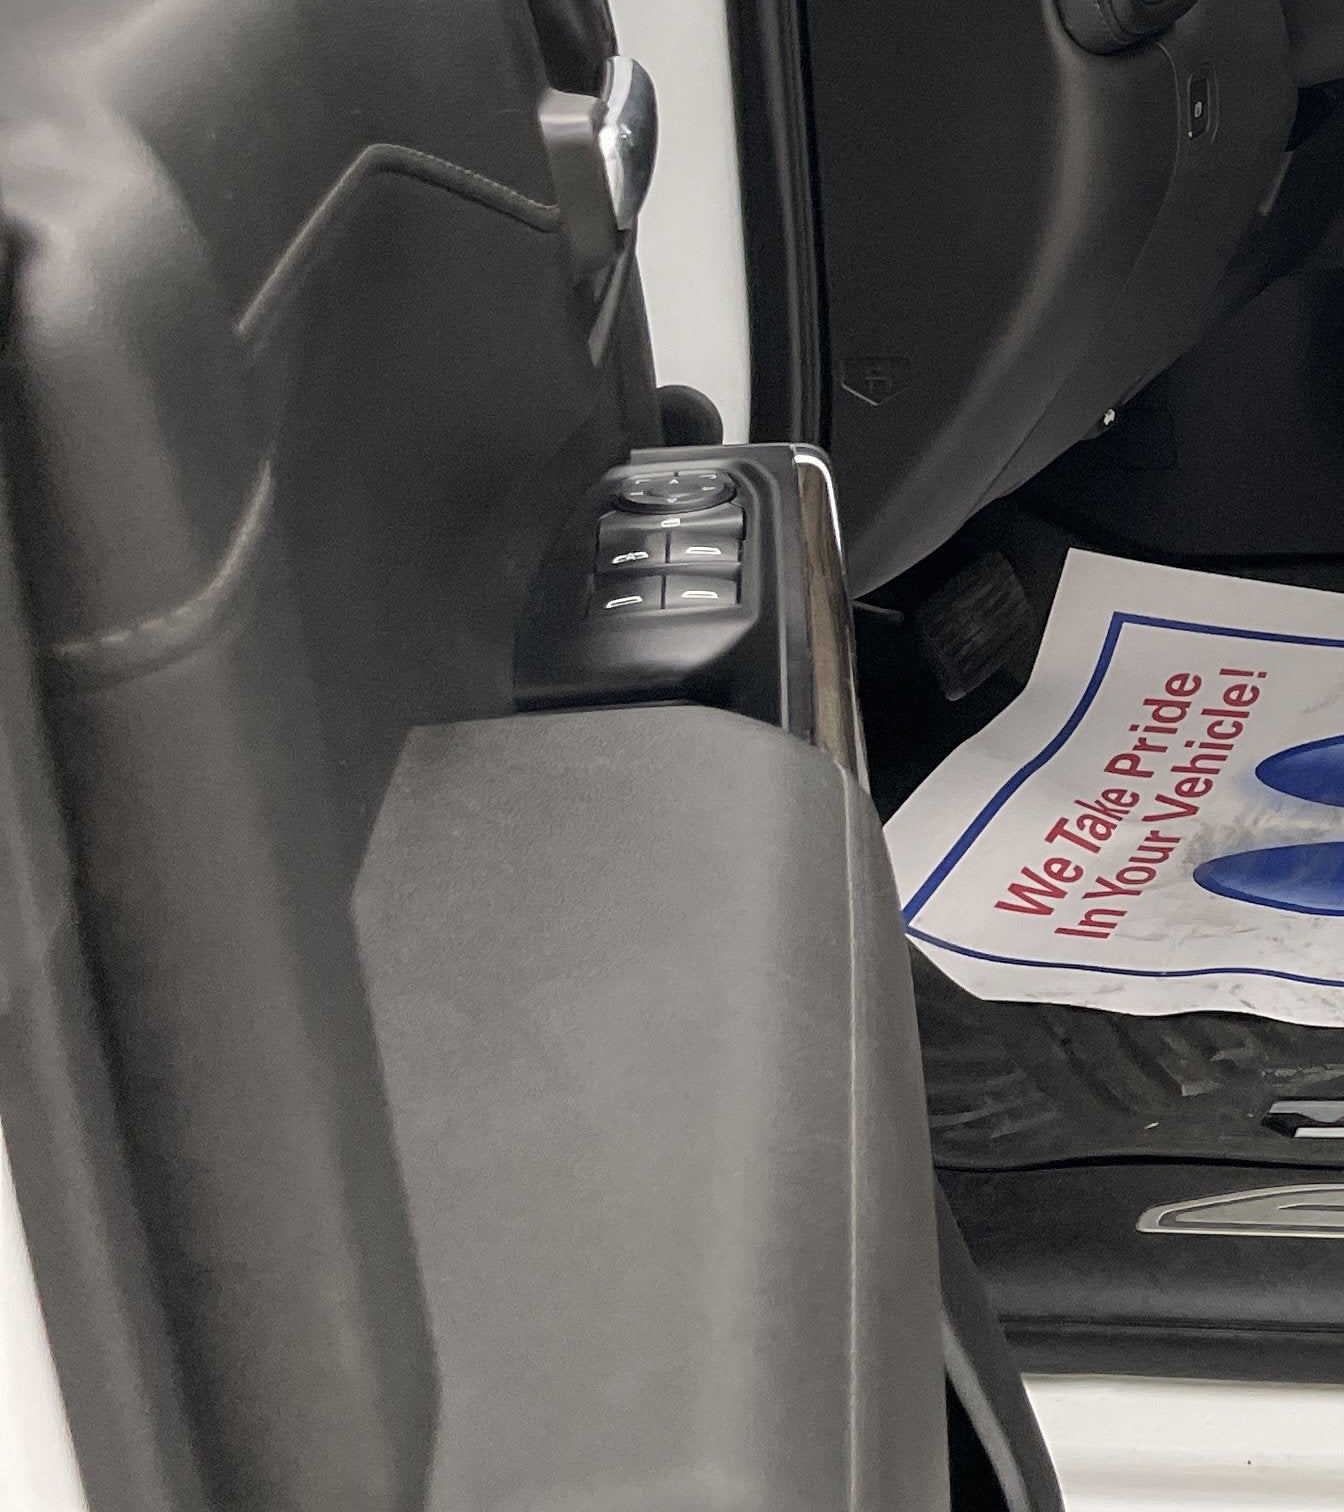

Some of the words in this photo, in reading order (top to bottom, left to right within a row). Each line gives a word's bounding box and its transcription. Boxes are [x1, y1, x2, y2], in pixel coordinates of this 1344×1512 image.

[993, 856, 1084, 916] We
[1044, 788, 1141, 854] Take
[1103, 672, 1202, 778] Pride
[1141, 668, 1269, 822] Vehicle!
[1081, 829, 1182, 899] Your
[1054, 908, 1128, 939] In
